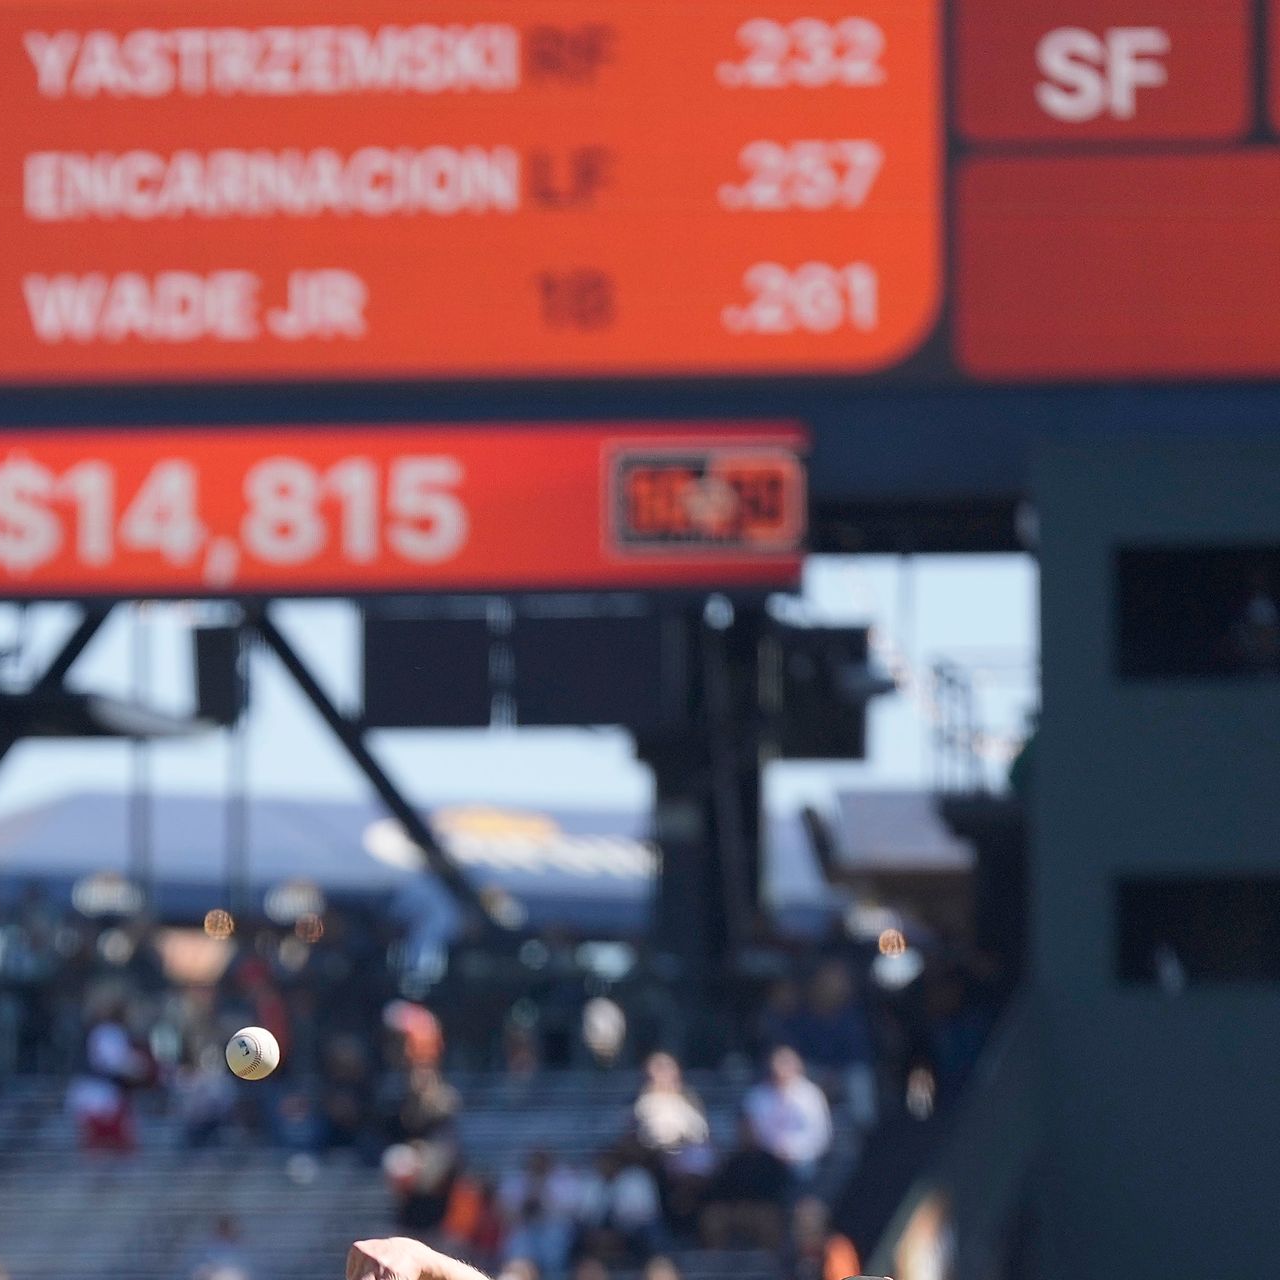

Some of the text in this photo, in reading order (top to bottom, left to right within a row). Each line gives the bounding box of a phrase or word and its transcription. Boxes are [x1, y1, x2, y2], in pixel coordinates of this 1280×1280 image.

[23, 23, 520, 98] YASTRZEMSKI
[715, 17, 886, 88] .232
[1035, 26, 1171, 122] SF
[23, 147, 520, 221] ENCARNACION
[529, 146, 618, 212] LF
[718, 140, 885, 211] .257
[22, 271, 260, 342] WADE
[265, 268, 368, 338] JR
